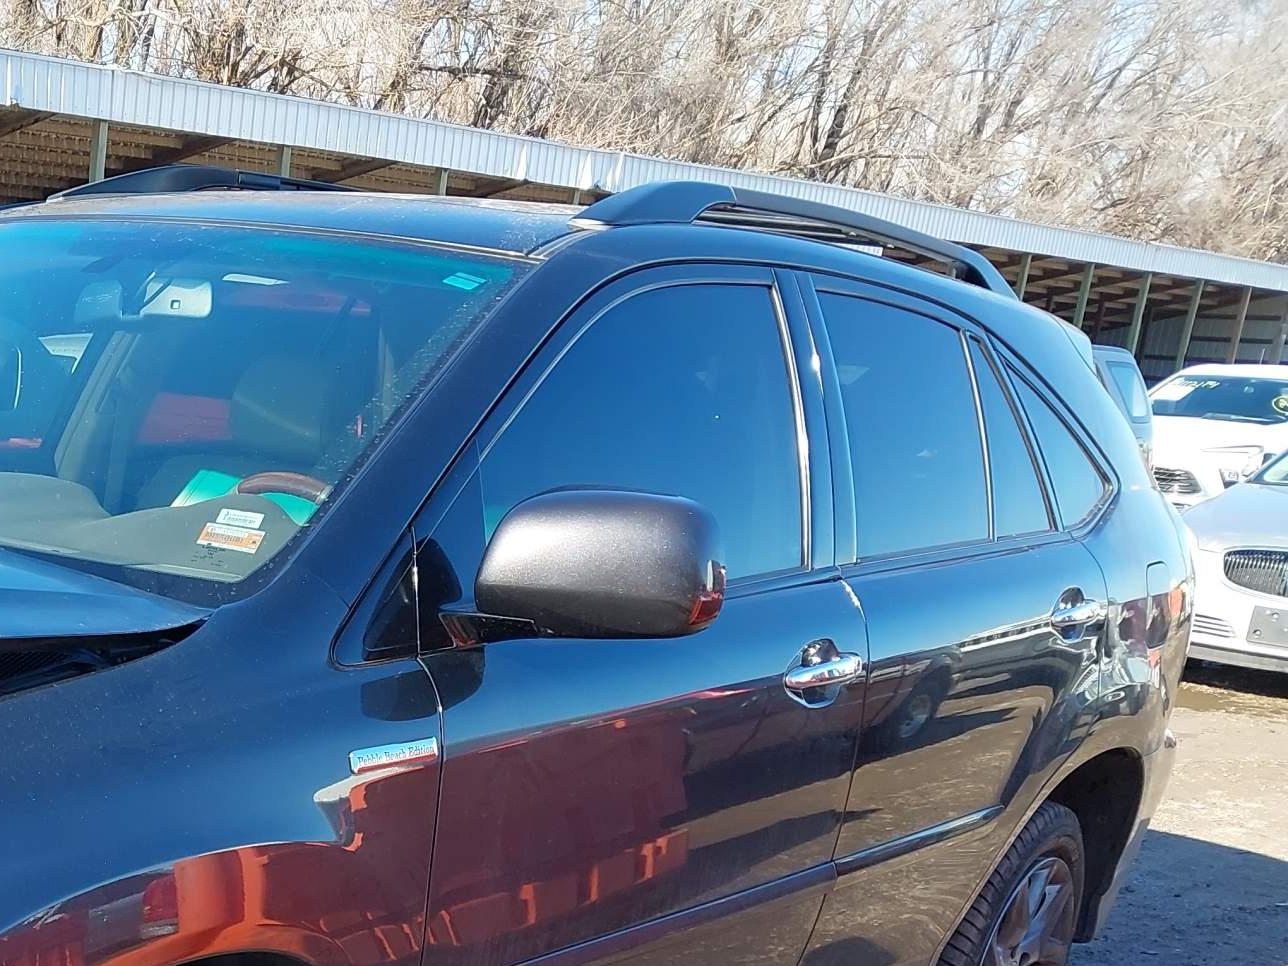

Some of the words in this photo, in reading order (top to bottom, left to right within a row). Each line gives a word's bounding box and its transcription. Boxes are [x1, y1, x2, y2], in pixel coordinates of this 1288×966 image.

[357, 752, 383, 766] Pebble
[384, 748, 406, 761] Beach
[408, 743, 435, 757] Edition
